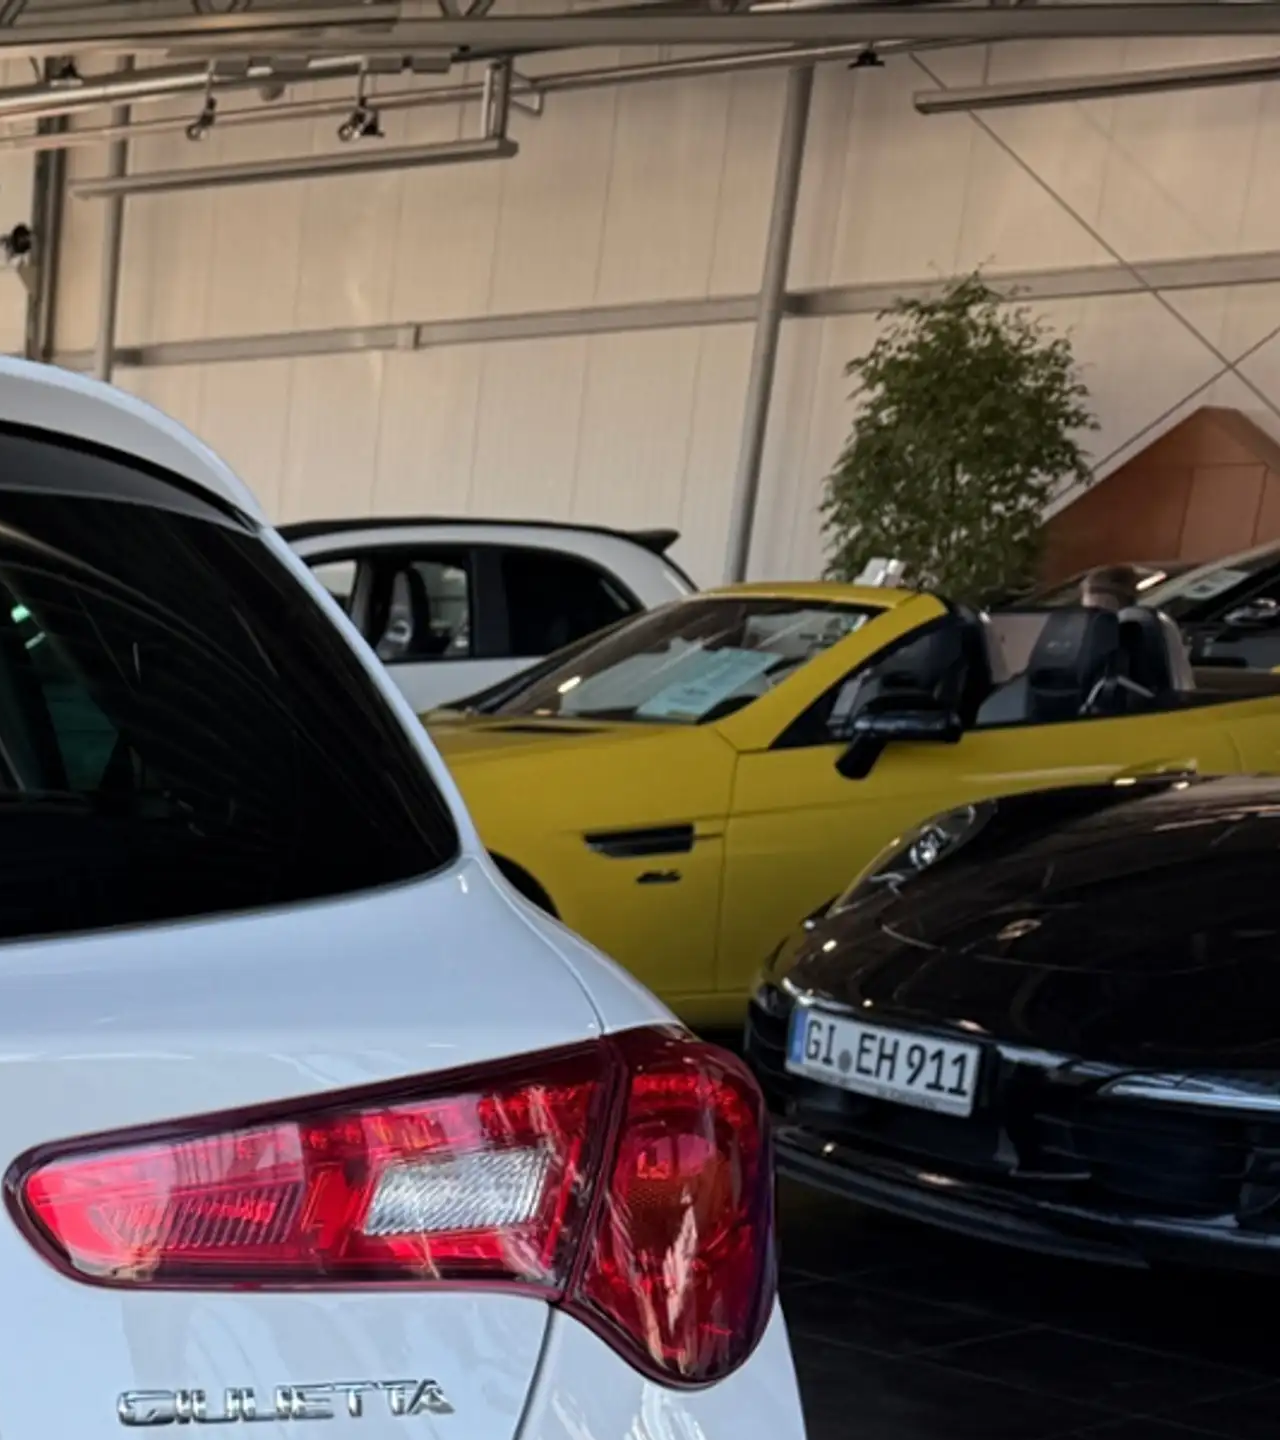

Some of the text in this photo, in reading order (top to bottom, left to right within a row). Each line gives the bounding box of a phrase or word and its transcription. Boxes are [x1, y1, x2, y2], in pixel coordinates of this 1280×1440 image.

[805, 1019, 837, 1066] GI
[855, 1032, 901, 1082] EH
[906, 1043, 969, 1097] 911
[116, 1379, 456, 1427] GIULIETTA
